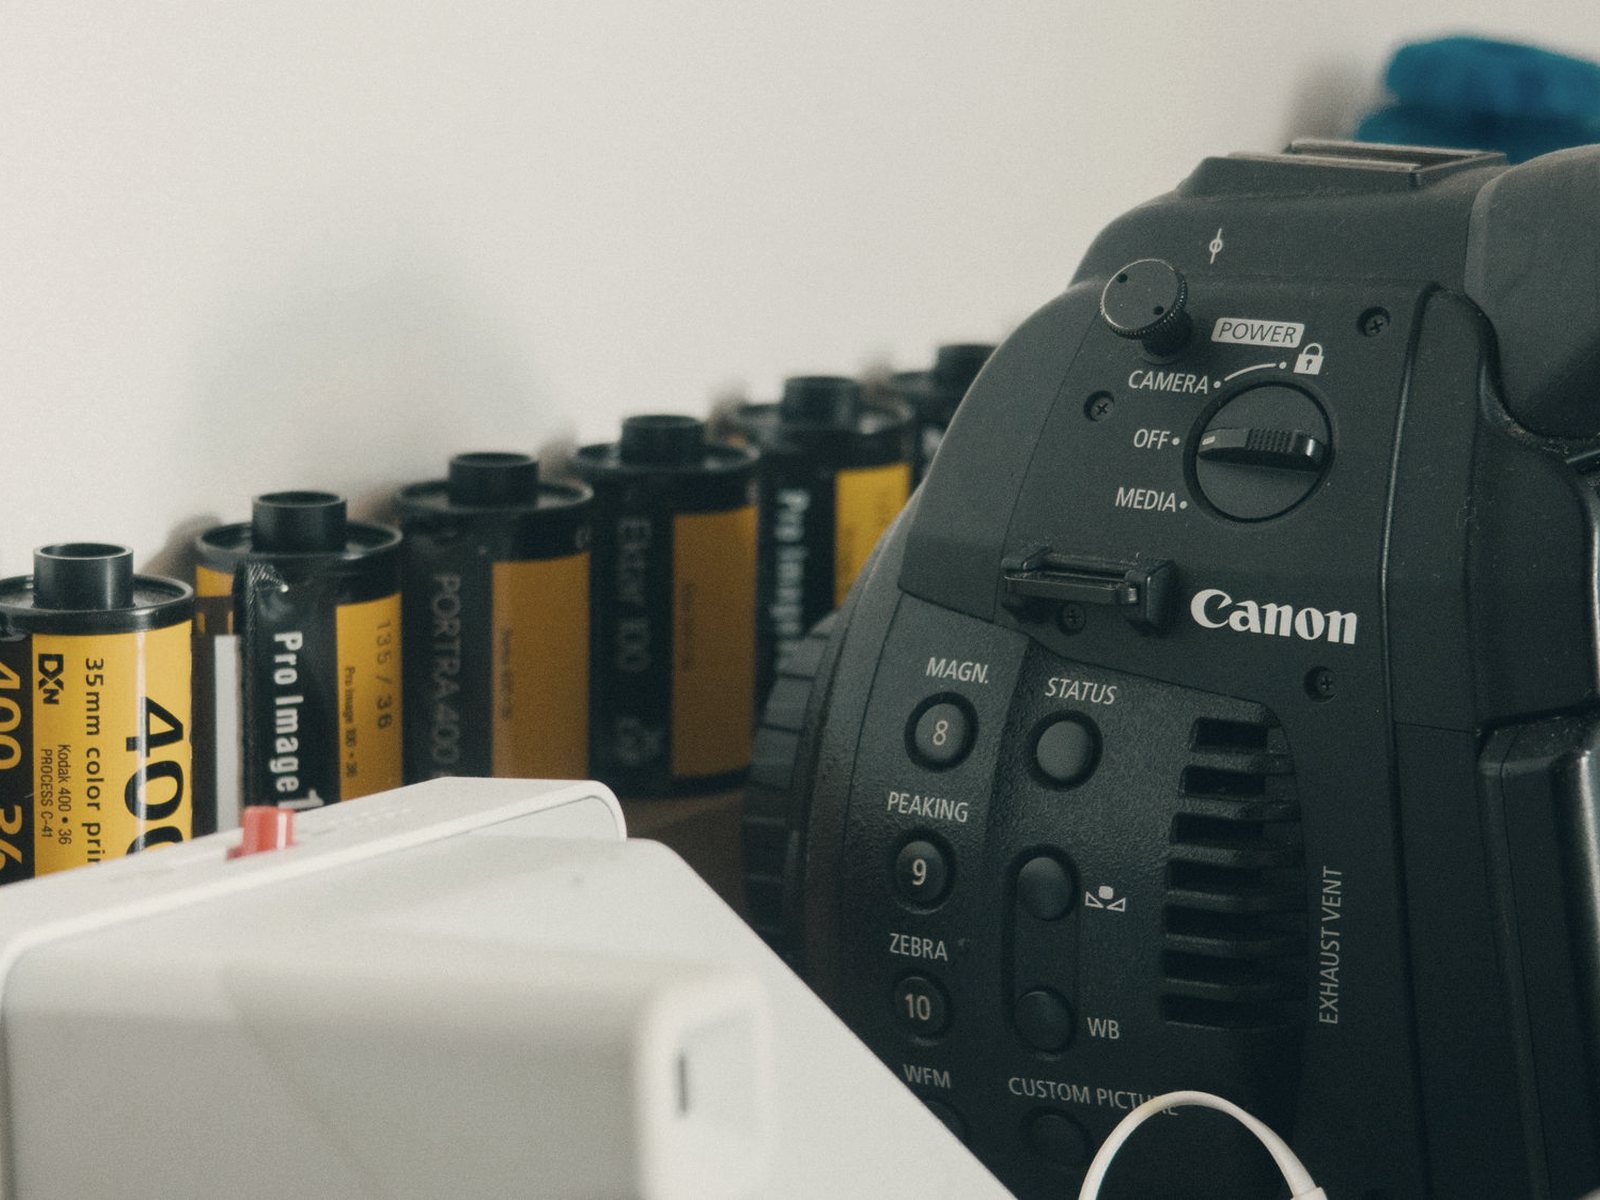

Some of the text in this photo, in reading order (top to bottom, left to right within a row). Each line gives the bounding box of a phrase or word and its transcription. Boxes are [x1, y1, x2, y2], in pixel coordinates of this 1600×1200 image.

[1218, 321, 1296, 344] POWER
[1128, 370, 1209, 394] CAMERA
[1133, 428, 1170, 450] OFF
[1114, 487, 1177, 512] MEDIA
[1190, 588, 1358, 645] Canon
[377, 619, 392, 665] 135
[273, 631, 303, 685] Pro
[925, 656, 990, 685] MAGN.
[1045, 677, 1118, 706] STATUS
[376, 693, 393, 730] 36
[269, 695, 304, 792] Image
[932, 719, 949, 746] 8
[81, 658, 105, 862] 35mm color pri
[40, 748, 54, 838] PROCESS C-41
[57, 744, 72, 845] Kodak 400 36
[887, 791, 969, 824] PEAKING
[911, 858, 928, 886] 9
[889, 933, 949, 962] ZEBRA
[1318, 866, 1342, 1025] EXHAUST VENT
[905, 992, 931, 1021] 10
[1087, 1016, 1121, 1041] WB
[903, 1063, 951, 1089] WFM
[1008, 1076, 1091, 1105] CUSTOM
